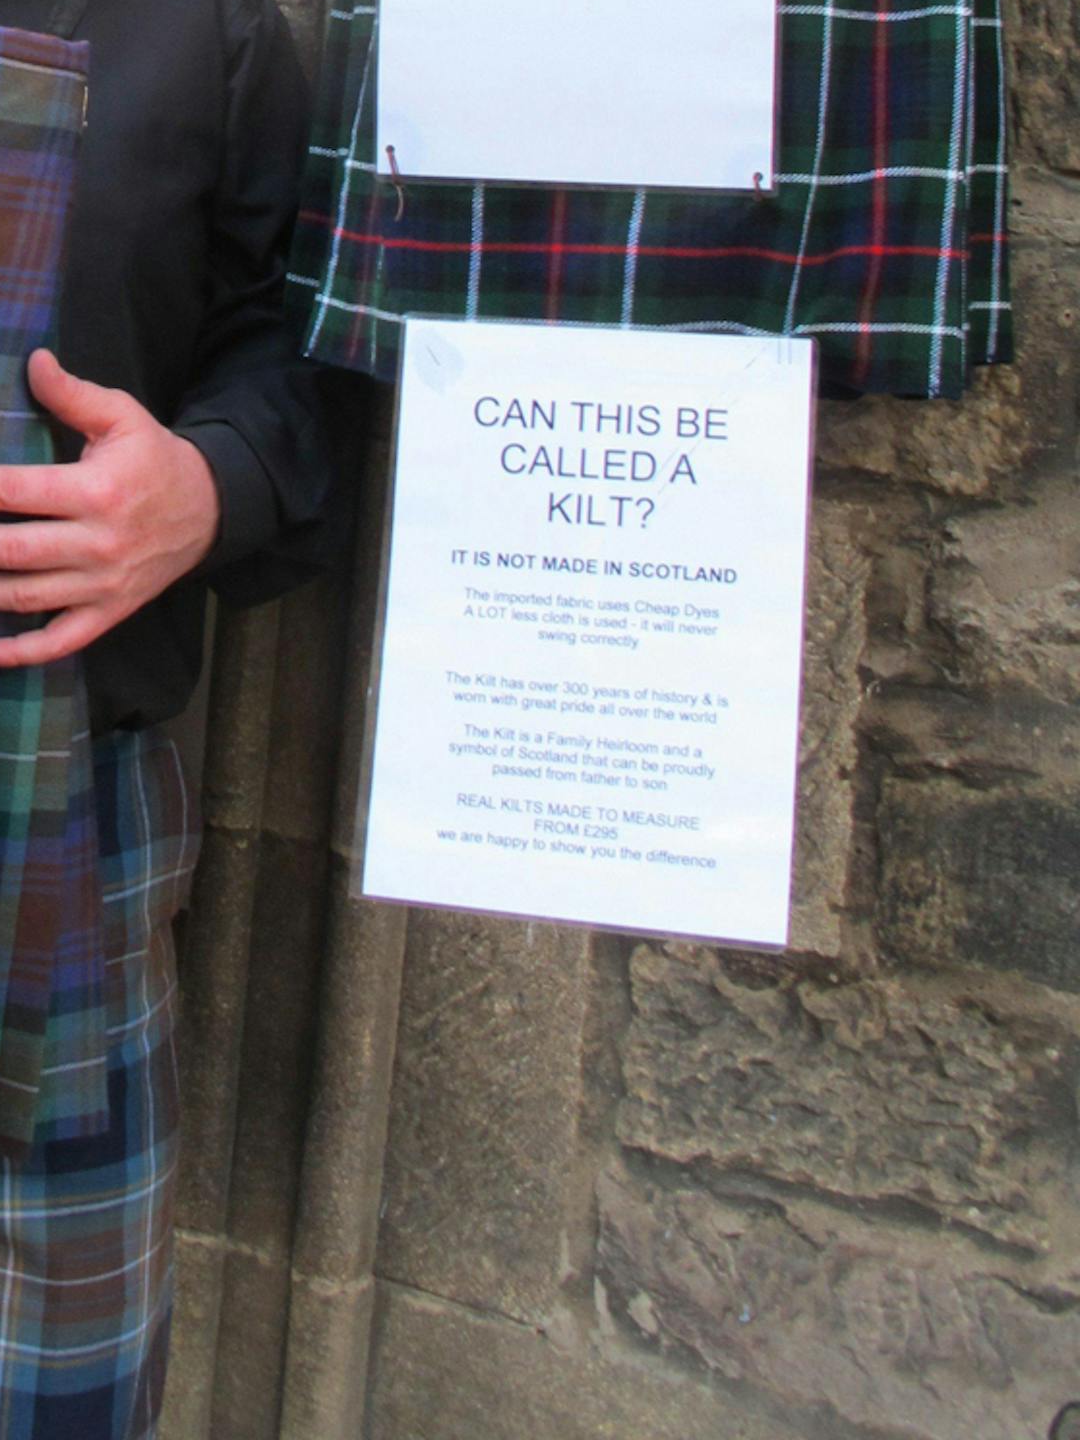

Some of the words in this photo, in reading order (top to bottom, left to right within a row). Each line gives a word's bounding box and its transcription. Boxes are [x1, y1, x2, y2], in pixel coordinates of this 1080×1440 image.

[473, 395, 556, 431] CAN
[571, 401, 661, 436] THIS
[676, 407, 729, 440] BE
[500, 443, 657, 482] CALLED
[669, 453, 697, 485] A
[547, 492, 656, 528] KILT?
[452, 549, 468, 564] IT
[474, 552, 490, 566] IS
[497, 553, 536, 570] NOT
[542, 556, 597, 574] MADE
[604, 560, 622, 575] IN
[629, 562, 737, 584] SCOTLAND
[464, 605, 474, 617] A
[478, 606, 507, 619] LOT
[511, 608, 538, 622] less
[542, 612, 574, 624] cloth
[578, 614, 589, 626] is
[593, 615, 627, 629] used
[640, 619, 648, 630] it
[652, 620, 674, 633] will
[678, 624, 717, 636] never
[465, 587, 490, 601] The
[493, 590, 552, 608] imported
[556, 595, 593, 610] fabric
[597, 599, 630, 612] uses
[634, 601, 679, 617] Cheap
[684, 604, 720, 619] Dyes
[538, 628, 576, 645] swing
[580, 632, 639, 649] correctly
[445, 671, 470, 686] The
[475, 674, 496, 687] Kilt
[500, 676, 524, 690] has
[528, 681, 558, 692] over
[563, 682, 589, 695] 300
[593, 685, 630, 699] years
[634, 688, 649, 700] of
[652, 689, 698, 706] history
[702, 693, 712, 705] &
[717, 695, 729, 708] is
[453, 691, 486, 703] worn
[490, 692, 517, 706] with
[521, 695, 557, 711] great
[560, 699, 595, 715] pride
[599, 702, 615, 715] all
[619, 707, 649, 718] over
[653, 707, 675, 720] the
[679, 710, 717, 724] world
[464, 724, 490, 738] The
[494, 727, 515, 740] Kilt
[519, 730, 530, 742] is
[534, 733, 543, 743] a
[547, 732, 593, 750] Family
[597, 737, 659, 754] Heirloom
[663, 743, 690, 757] and
[693, 747, 702, 758] a
[448, 741, 497, 757] symbol
[501, 744, 515, 758] of
[518, 746, 579, 764] Scotland
[582, 752, 608, 766] that
[611, 758, 638, 769] can
[642, 758, 659, 772] be
[663, 759, 716, 779] proudly
[492, 761, 542, 778] passed
[545, 767, 577, 782] from
[580, 770, 622, 786] father
[625, 776, 638, 787] to
[642, 779, 668, 790] son
[456, 792, 496, 810] REAL
[500, 797, 543, 814] KILTS
[547, 803, 592, 819] MADE
[597, 807, 619, 822] TO
[622, 810, 701, 830] MEASURE
[534, 819, 580, 836] FROM
[583, 824, 619, 839] £295
[436, 829, 457, 840] we
[460, 832, 483, 843] are
[487, 832, 528, 851] happy
[533, 837, 546, 850] to
[550, 841, 587, 855] show
[591, 846, 616, 859] you
[620, 848, 642, 861] the
[646, 850, 717, 869] difference
